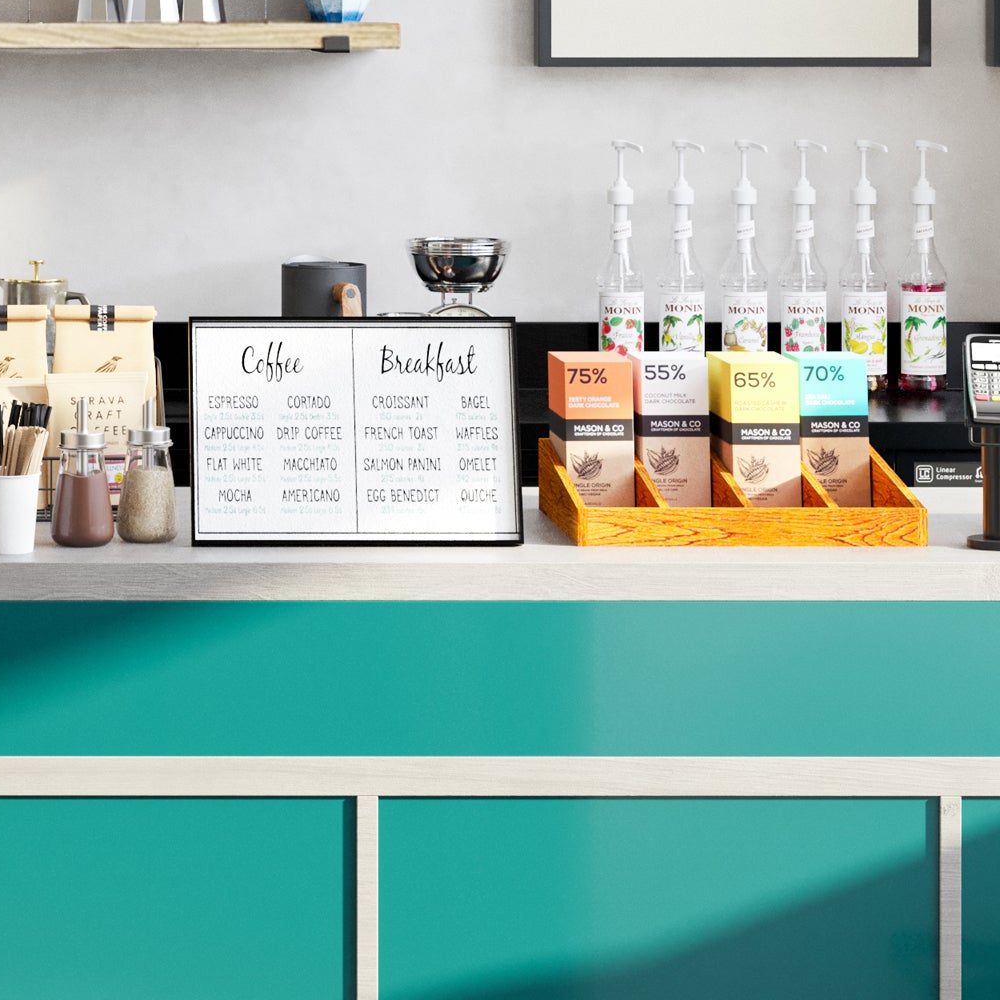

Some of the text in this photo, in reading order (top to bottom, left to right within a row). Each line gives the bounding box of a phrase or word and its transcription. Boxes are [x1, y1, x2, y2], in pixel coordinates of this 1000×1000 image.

[604, 306, 641, 315] MONIN
[665, 304, 703, 312] MONIN
[728, 305, 765, 314] MONIN
[787, 306, 824, 314] MONIN
[848, 306, 885, 314] MONIN
[908, 304, 944, 313] MONIN
[241, 341, 304, 382] Coffee
[380, 341, 477, 382] Breakfast
[567, 368, 607, 384] 75%
[645, 365, 686, 381] 55%
[734, 372, 776, 388] 65%
[803, 366, 844, 381] 70%
[208, 395, 259, 409] ESPRESSO
[287, 395, 331, 409] CORTADO
[372, 395, 429, 409] CROISSANT
[461, 395, 491, 409] BAGEL
[204, 426, 264, 440] CAPPUCCINO
[277, 426, 342, 440] DRIP COFFEE
[364, 426, 438, 440] FRENCH TOAST
[456, 426, 499, 440] WAFFLES
[574, 424, 624, 432] MASON & CO
[206, 457, 262, 471] FLAT WHITE
[283, 457, 337, 471] MACCHIATO
[363, 457, 441, 471] SALMON PANINI
[459, 457, 497, 471] OMELET
[935, 473, 973, 481] Compressor
[218, 489, 252, 502] MOCHA
[282, 489, 340, 502] AMERICANO
[367, 489, 439, 502] EGG BENEDICT
[460, 489, 497, 502] QUICHE
